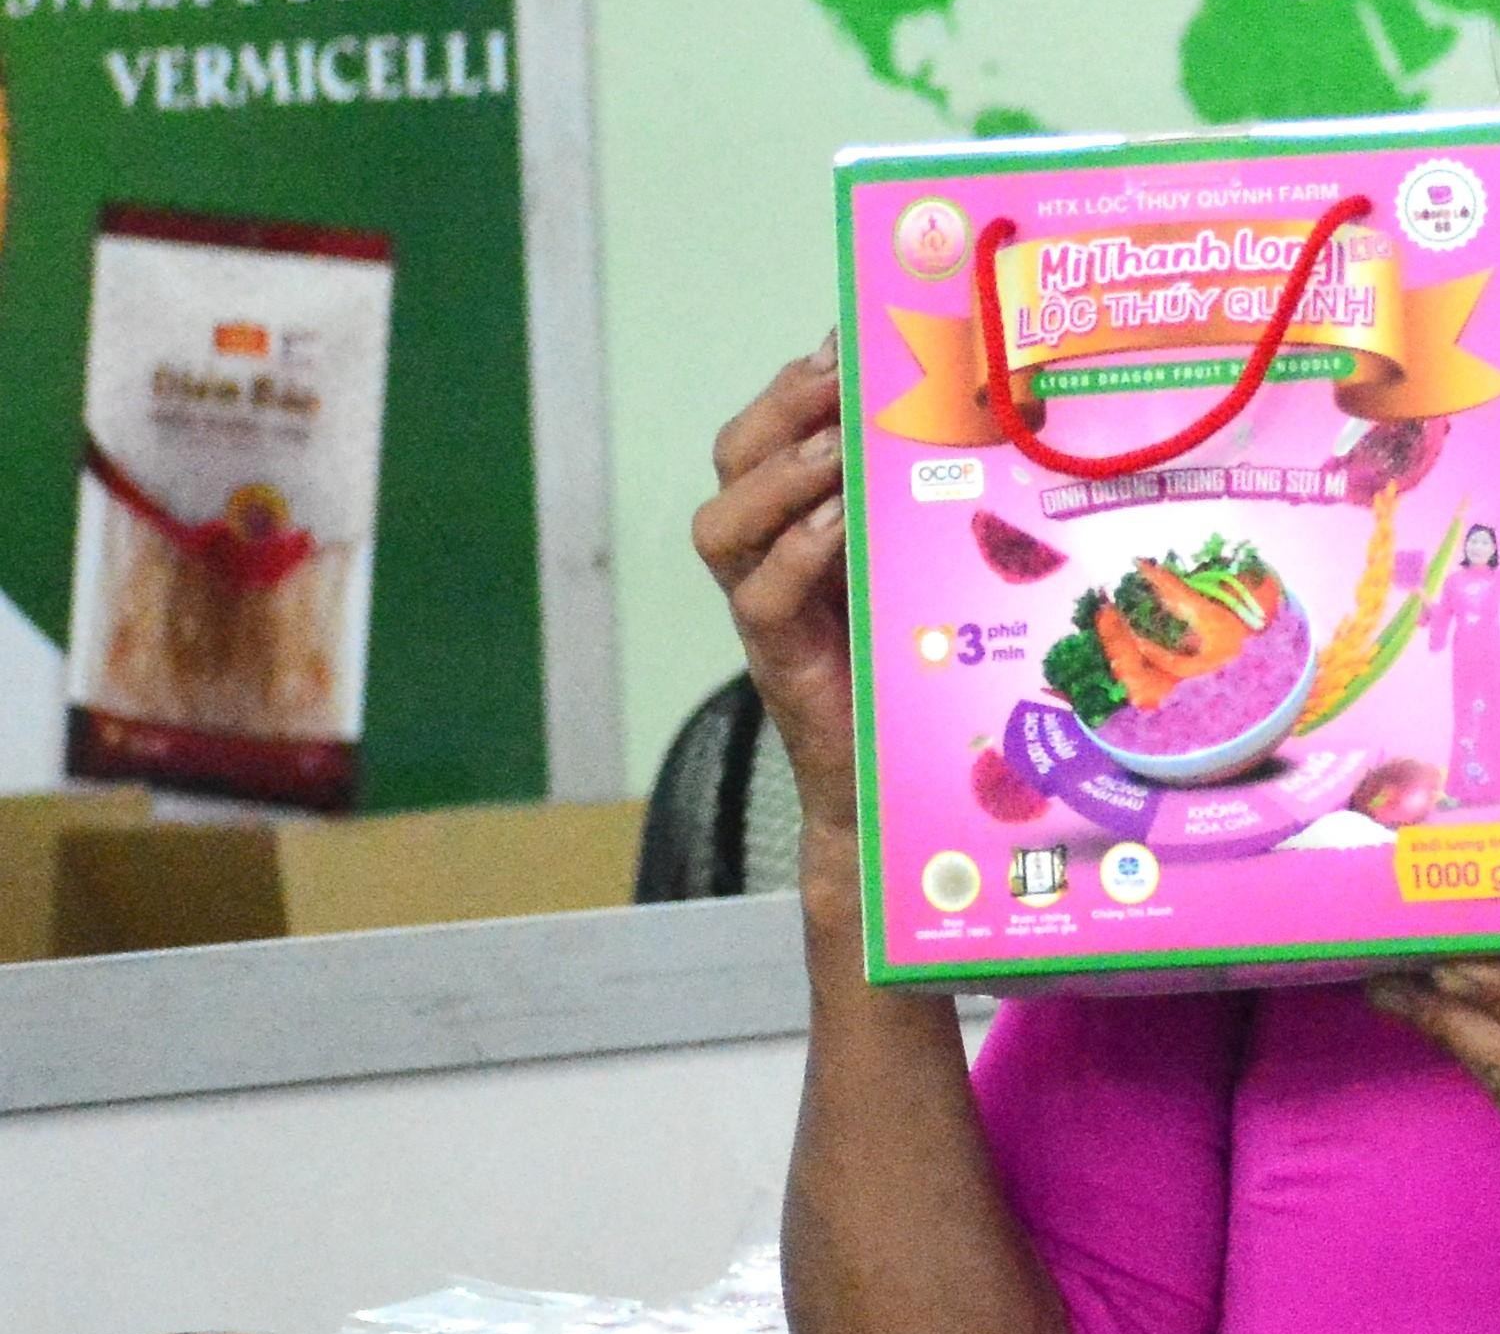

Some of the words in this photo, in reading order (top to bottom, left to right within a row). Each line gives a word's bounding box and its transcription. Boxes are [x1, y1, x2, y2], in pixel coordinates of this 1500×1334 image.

[103, 29, 508, 110] VERMICELLI
[1039, 240, 1094, 296] Mì
[1095, 230, 1229, 284] Thanh
[1015, 291, 1097, 349] LỘC
[1103, 281, 1221, 327] THÚY
[919, 461, 974, 482] OCOP
[1164, 468, 1225, 495] TRONG
[956, 622, 987, 666] 3
[987, 622, 1029, 640] phút
[992, 644, 1025, 662] min
[1410, 860, 1480, 890] 1000
